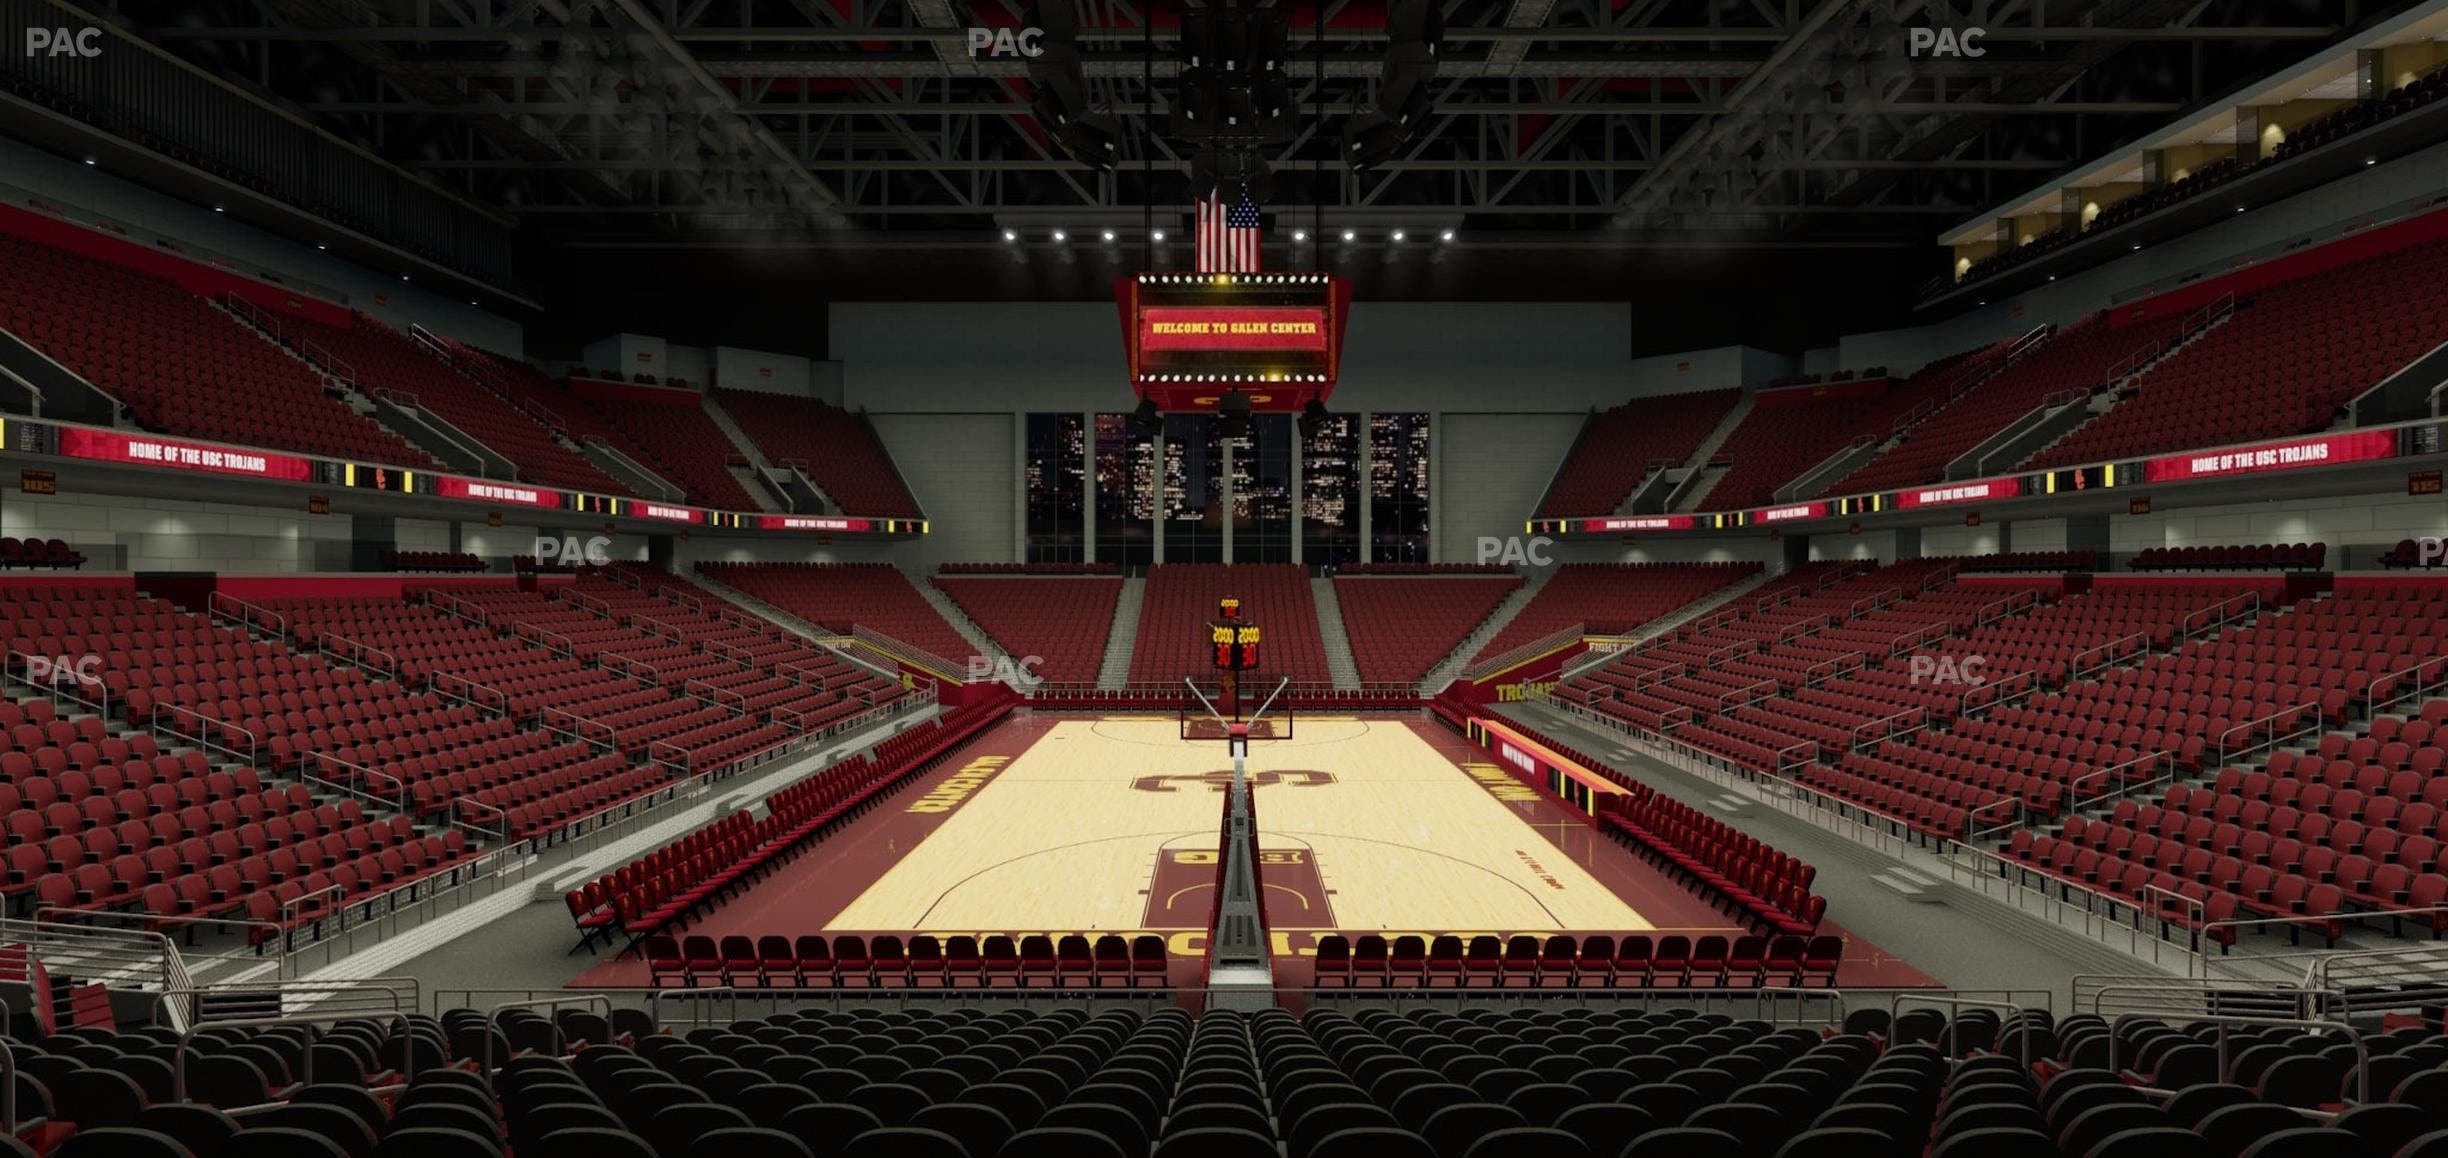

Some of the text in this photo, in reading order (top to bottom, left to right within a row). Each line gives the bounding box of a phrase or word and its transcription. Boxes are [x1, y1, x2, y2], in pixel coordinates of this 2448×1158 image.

[1152, 322, 1316, 334] WELCOME TO GALEN CENTER
[129, 441, 266, 472] HOME OF THE USC TROJANS
[2192, 443, 2328, 473] HOME OF THE USC TROJANS
